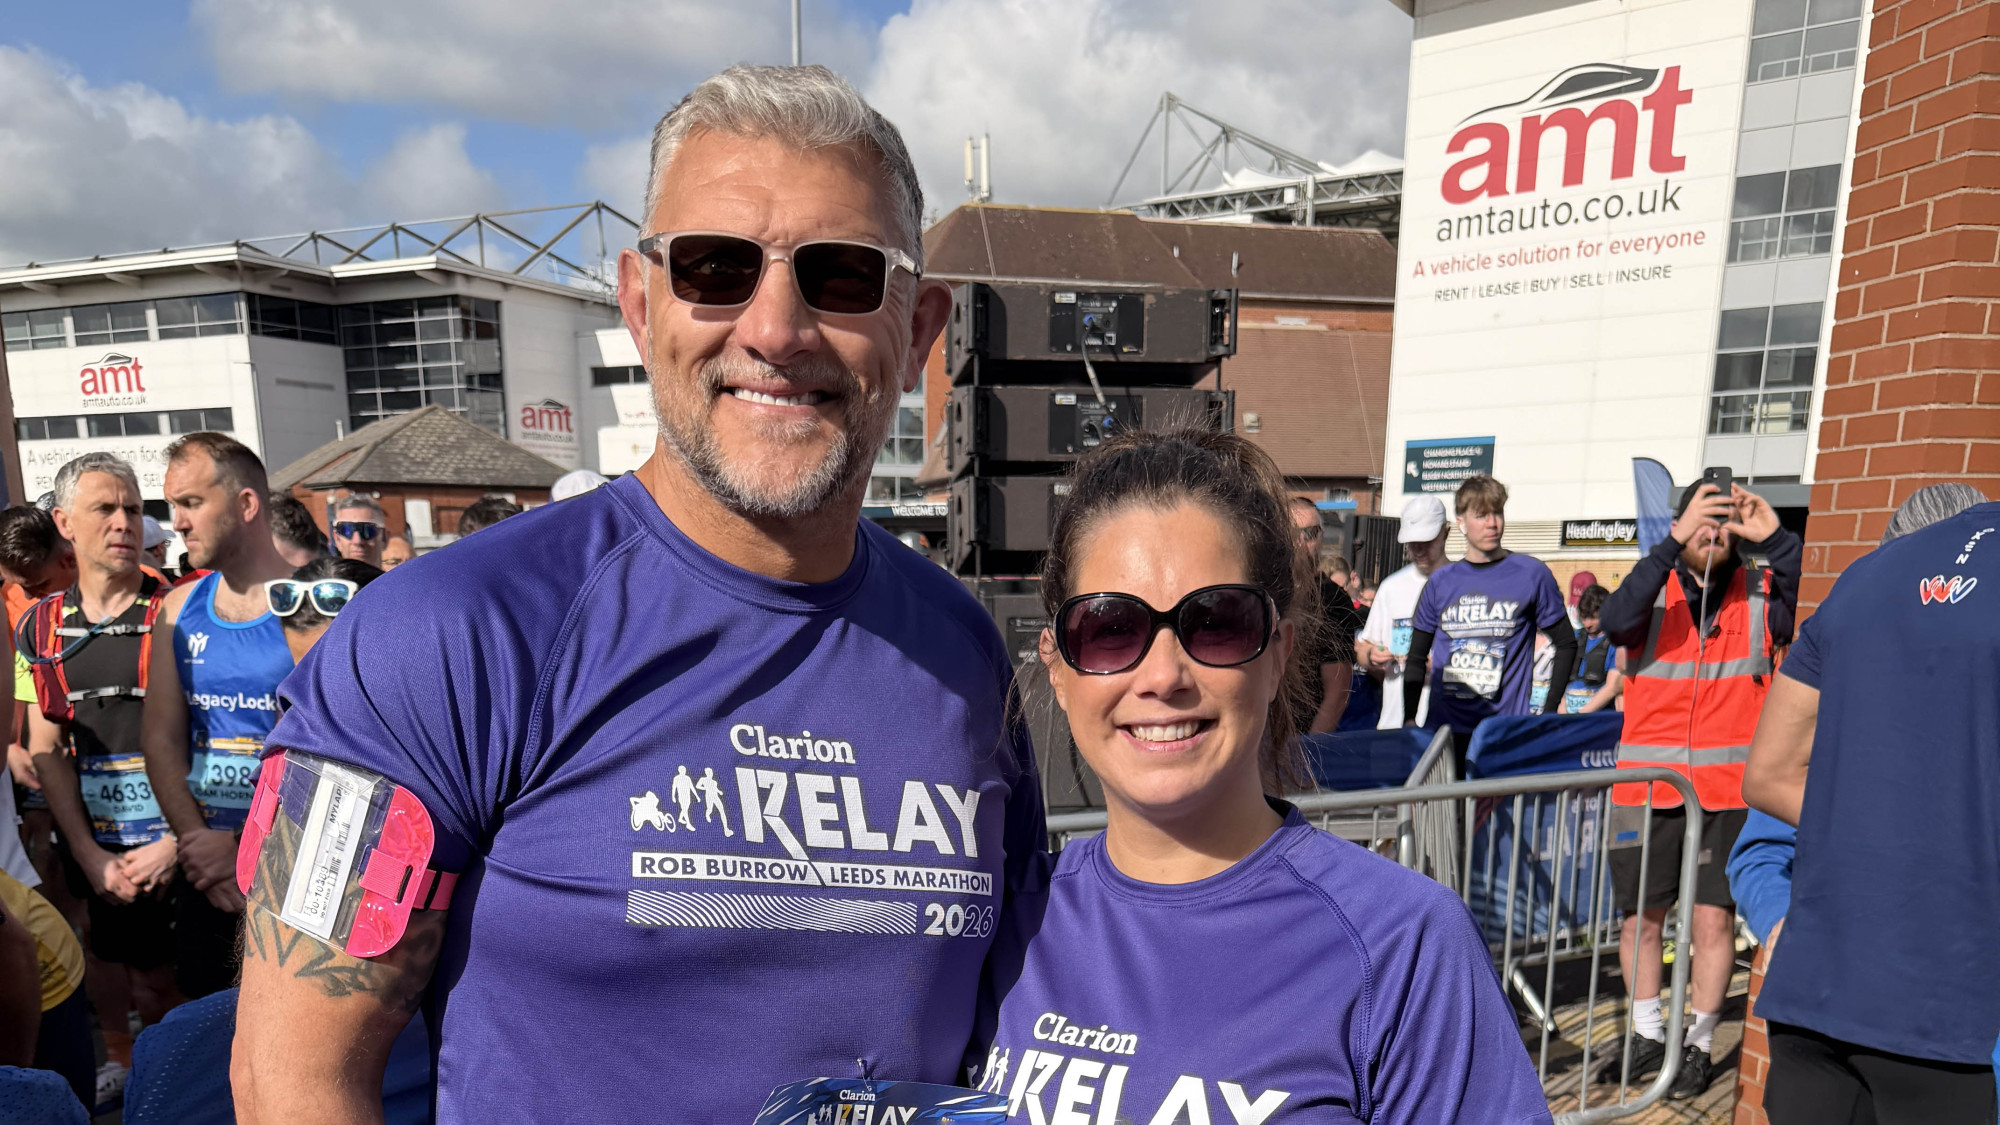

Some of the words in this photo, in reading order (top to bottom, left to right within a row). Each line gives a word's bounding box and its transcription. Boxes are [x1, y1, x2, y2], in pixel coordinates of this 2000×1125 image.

[1440, 65, 1693, 204] amt
[1436, 179, 1682, 242] amtauto.co.uk
[1412, 260, 1425, 279] A
[1430, 254, 1492, 277] vehicle
[1497, 244, 1571, 269] solution
[1577, 239, 1602, 258] for
[1609, 229, 1706, 256] everyone
[1434, 287, 1469, 302] RENT
[1479, 281, 1520, 299] LEASE
[1530, 277, 1561, 293] BUY
[1569, 273, 1604, 289] SELL
[1615, 265, 1673, 284] INSURE
[80, 357, 146, 396] amt
[521, 405, 573, 433] amt
[1566, 520, 1636, 542] Headingley
[1458, 601, 1519, 626] RELAY
[729, 723, 856, 764] Clarion
[100, 781, 152, 803] 4633
[329, 785, 344, 824] MYLAP
[734, 766, 981, 860] RELAY
[640, 856, 697, 877] ROB
[706, 857, 808, 882] BURROW
[830, 866, 886, 887] LEEDS
[893, 869, 990, 893] MARATHON
[924, 903, 993, 938] 2026
[1033, 1012, 1138, 1055] Clarion
[839, 1089, 876, 1102] Clarion
